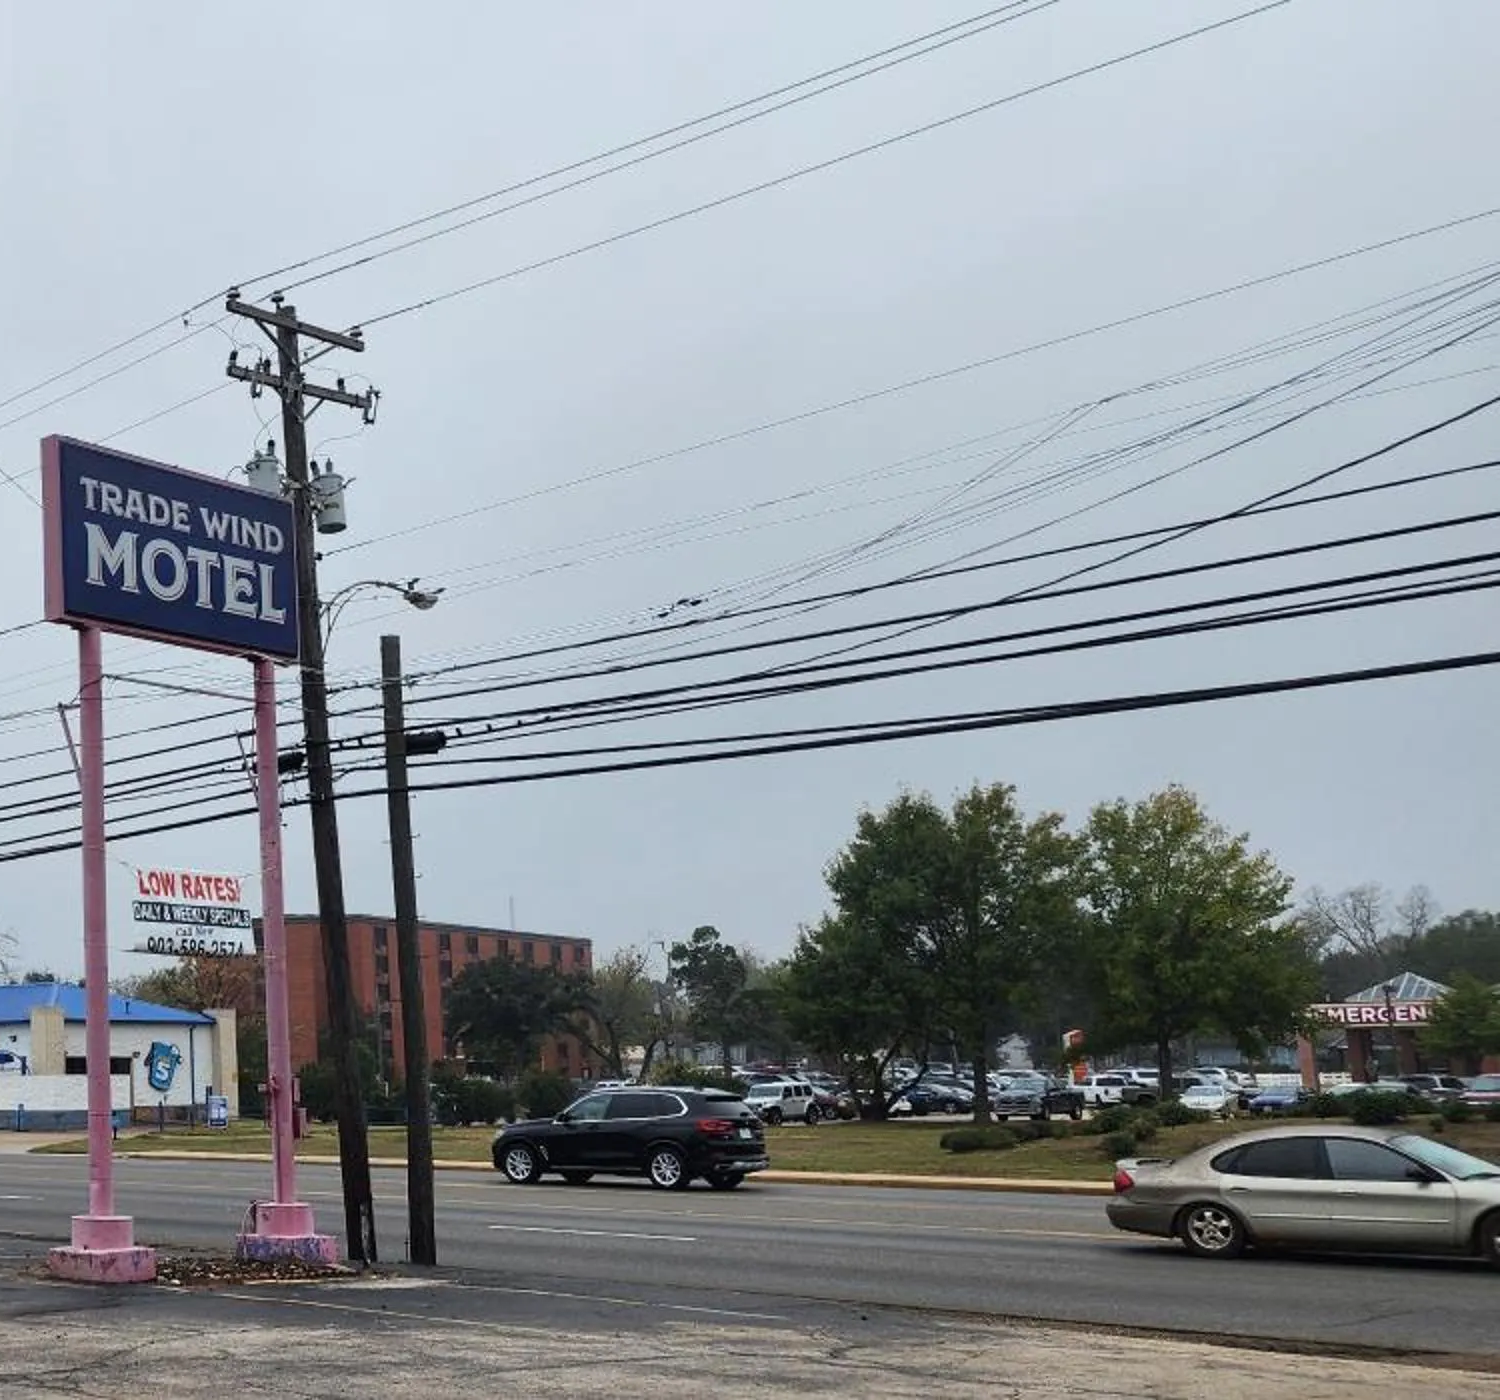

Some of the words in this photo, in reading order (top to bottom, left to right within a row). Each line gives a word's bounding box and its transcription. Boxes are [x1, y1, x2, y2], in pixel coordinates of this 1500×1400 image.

[79, 476, 192, 533] TRADE
[200, 507, 285, 554] WIND
[83, 521, 286, 624] MOTEL
[137, 870, 176, 897] LOW
[181, 873, 241, 903] RATES!
[133, 902, 161, 920] DAILY
[163, 904, 171, 921] &
[172, 905, 208, 923] WEEKLY
[209, 908, 250, 927] SPECIALS
[1314, 1004, 1435, 1023] MERGEN
